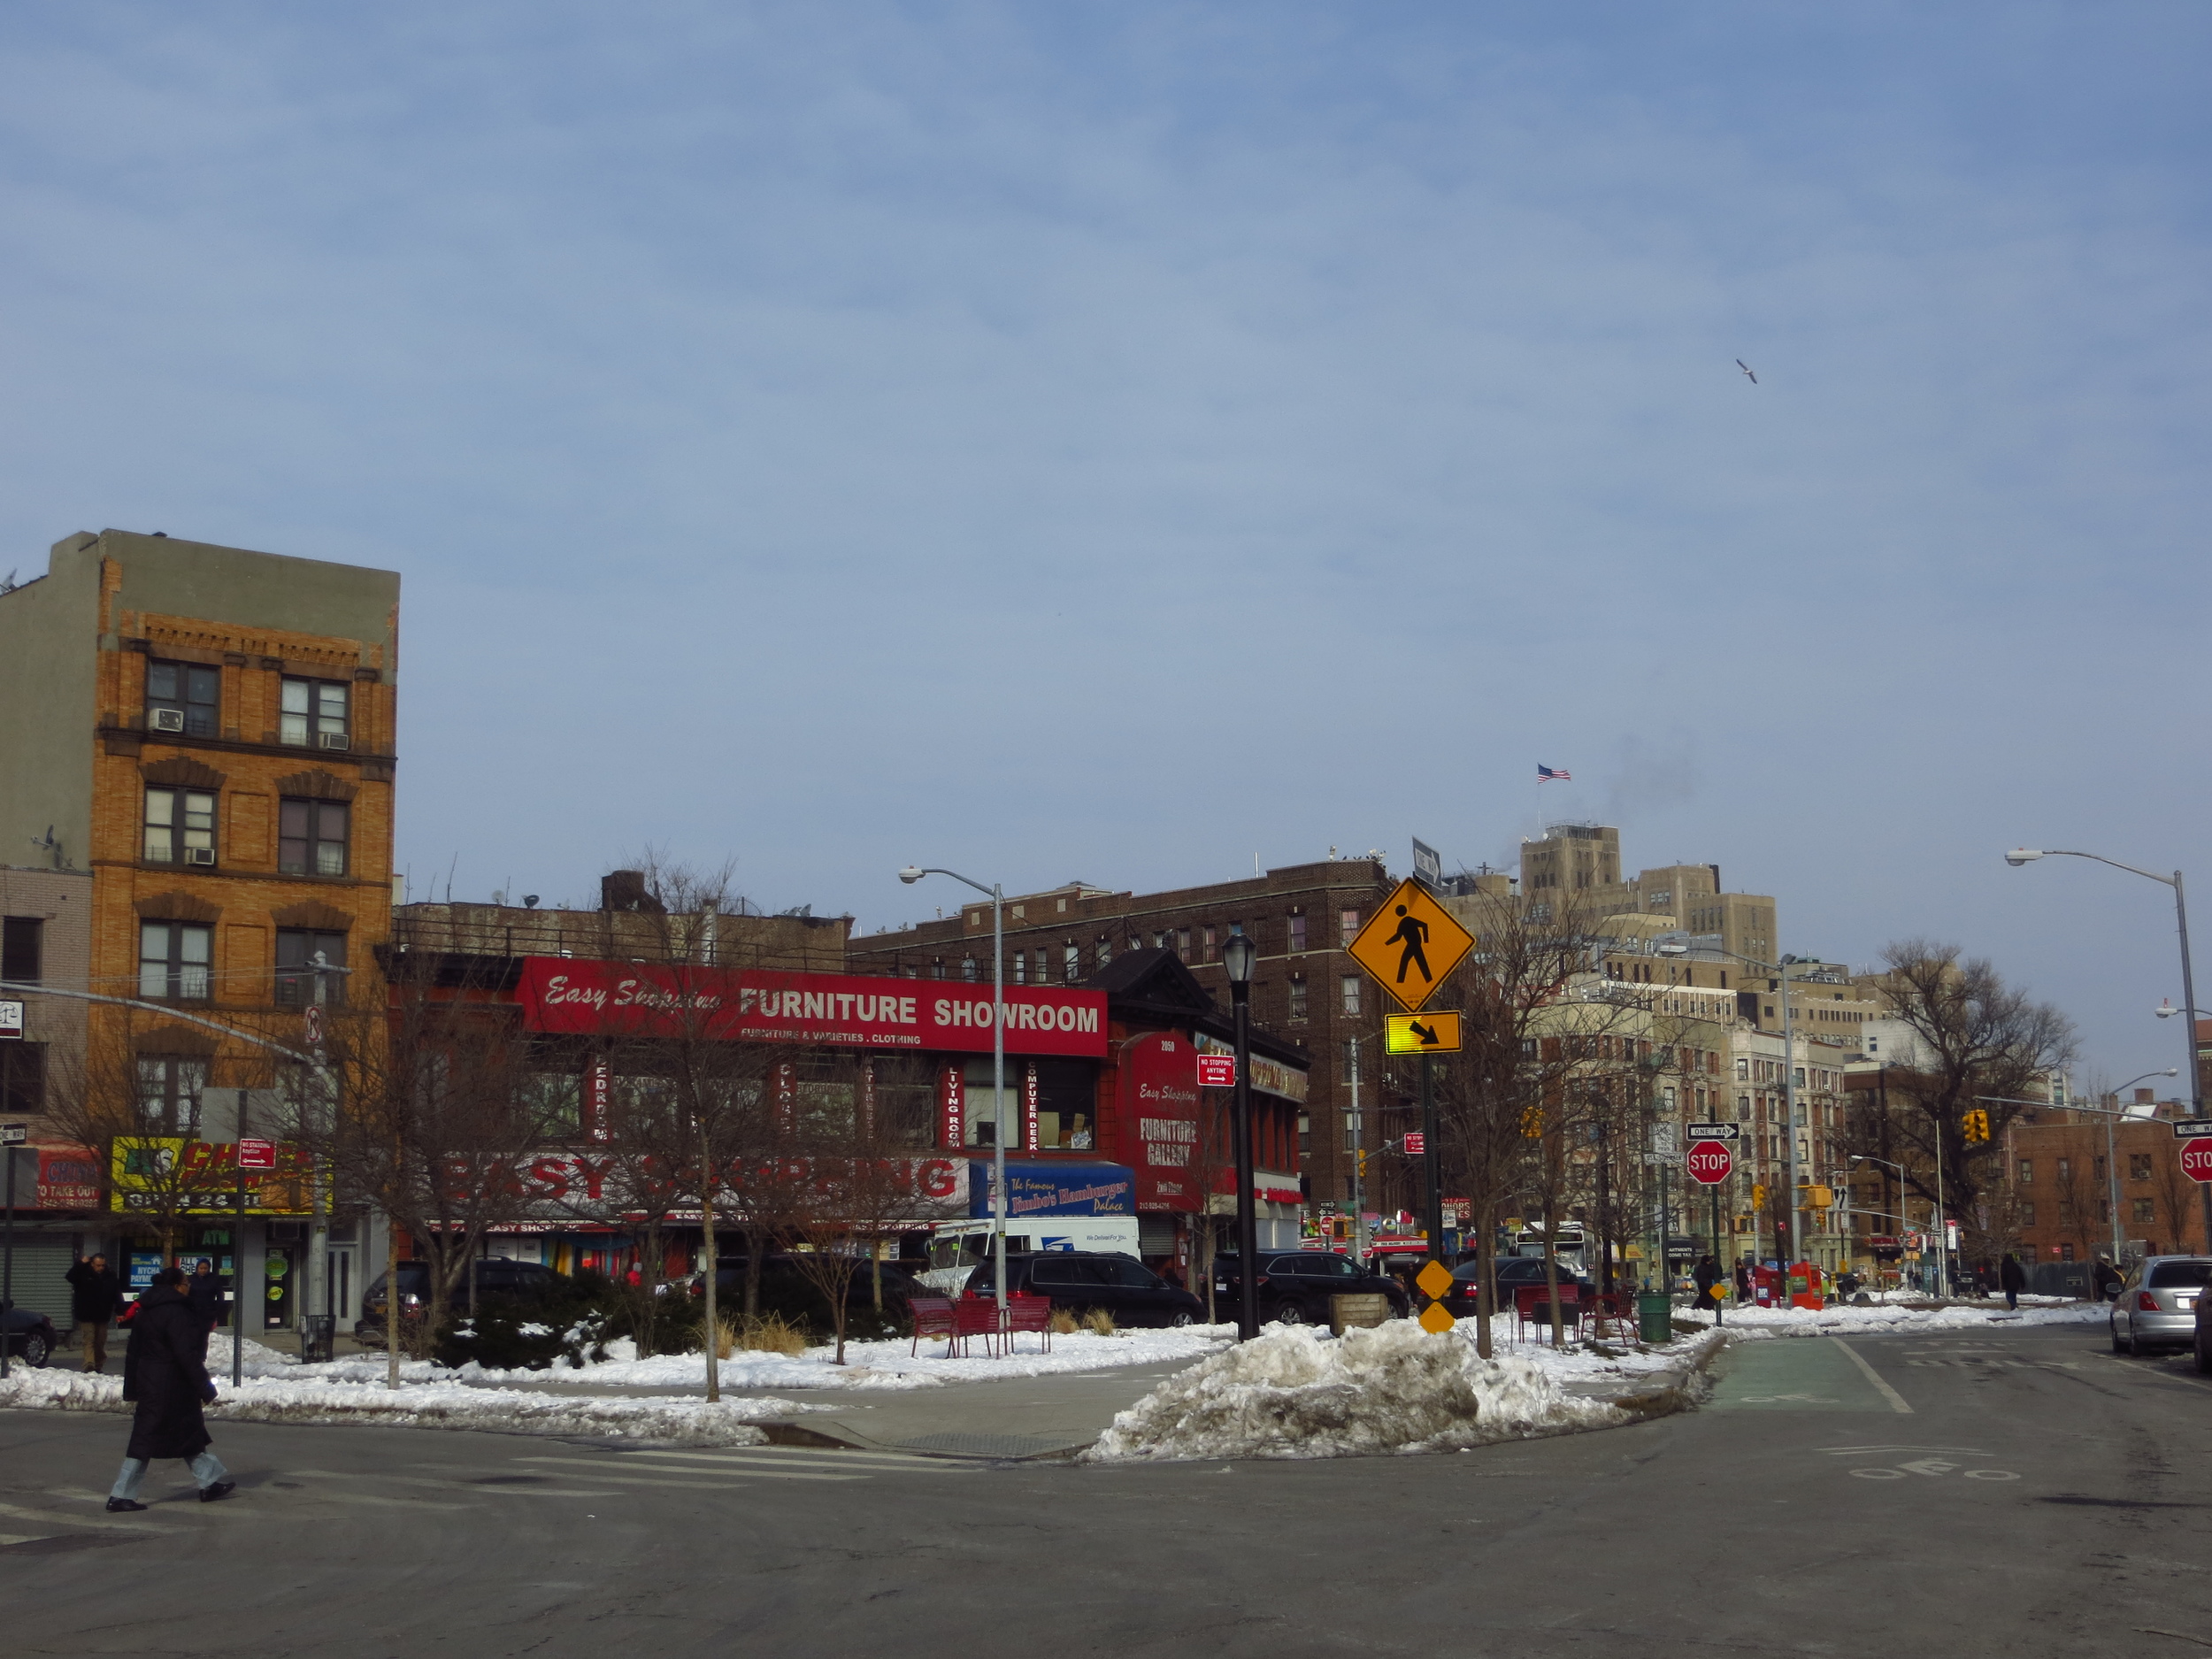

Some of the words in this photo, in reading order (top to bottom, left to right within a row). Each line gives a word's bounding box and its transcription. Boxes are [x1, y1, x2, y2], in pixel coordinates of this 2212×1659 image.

[545, 975, 608, 1010] Easy
[741, 987, 917, 1024] FURNITURE
[934, 998, 1098, 1033] SHOWROOM
[812, 1032, 864, 1042] VARIETIES
[872, 1033, 921, 1044] CLOTHING
[1161, 1040, 1175, 1052] 2050
[595, 1055, 608, 1140] EDROM
[948, 1067, 959, 1113] LIVING
[1027, 1061, 1037, 1118] COMPUTER
[1140, 1083, 1159, 1101] Easy
[1162, 1086, 1197, 1104] Shopping
[949, 1117, 960, 1147] ROOM
[1029, 1122, 1038, 1150] DESK
[1140, 1118, 1197, 1142] FURNITURE
[1147, 1142, 1191, 1166] GALLERY
[1690, 1154, 1729, 1170] STOP
[50, 1187, 75, 1196] TAKE
[77, 1186, 97, 1197] OUT
[1011, 1178, 1025, 1191] The
[1025, 1179, 1056, 1192] Famous
[128, 1194, 190, 1207] OPN
[199, 1194, 228, 1207] 24
[1012, 1192, 1057, 1214] Jimbo's
[1058, 1181, 1130, 1204] Hamburger
[1094, 1198, 1124, 1213] Palace
[202, 1229, 229, 1245] ATM
[137, 1266, 160, 1275] NYCHA
